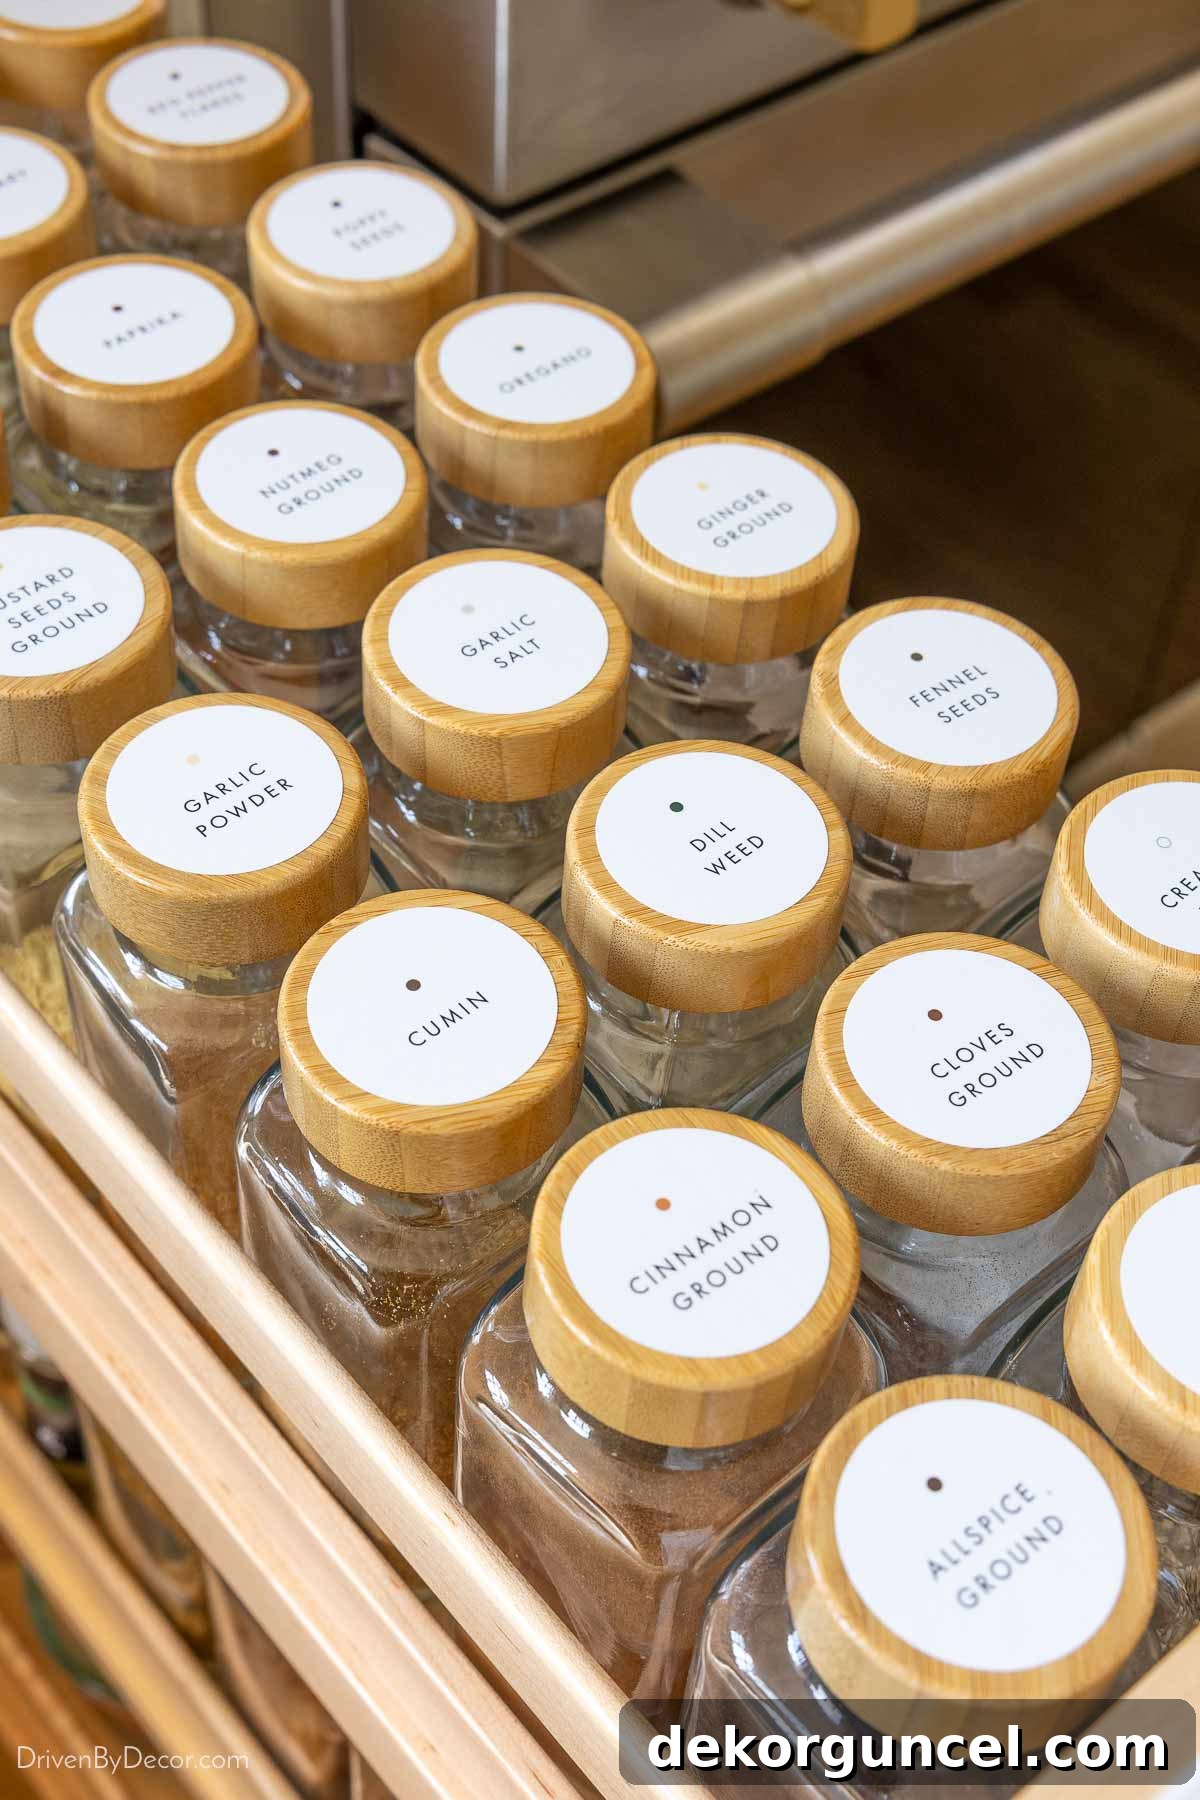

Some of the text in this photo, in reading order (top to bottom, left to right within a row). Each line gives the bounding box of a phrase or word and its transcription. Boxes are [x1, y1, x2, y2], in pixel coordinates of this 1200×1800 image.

[103, 311, 182, 349] PAPRIKA
[498, 347, 593, 393] OREGANO
[258, 453, 343, 499] NUTMEG
[276, 467, 364, 515] GROUND
[696, 488, 769, 531] GINGER
[712, 501, 794, 548] GROUND
[7, 591, 77, 629] SEEDS
[10, 601, 109, 654] GROUND
[460, 613, 536, 657] GARLIC
[493, 637, 543, 669] SALT
[908, 665, 988, 708] FENNEL
[936, 687, 1000, 724] SEEDS
[183, 762, 266, 813] GARLIC
[195, 778, 294, 838] POWDER
[689, 821, 736, 853] DILL
[703, 835, 764, 876] WEED
[407, 991, 489, 1047] CUMIN
[930, 1022, 1014, 1079] CLOVES
[948, 1043, 1044, 1107] GROUND
[629, 1194, 773, 1295] CINNAMON
[672, 1234, 780, 1311] GROUND
[927, 1482, 1036, 1581] ALLSPICE
[956, 1515, 1064, 1610] GROUND
